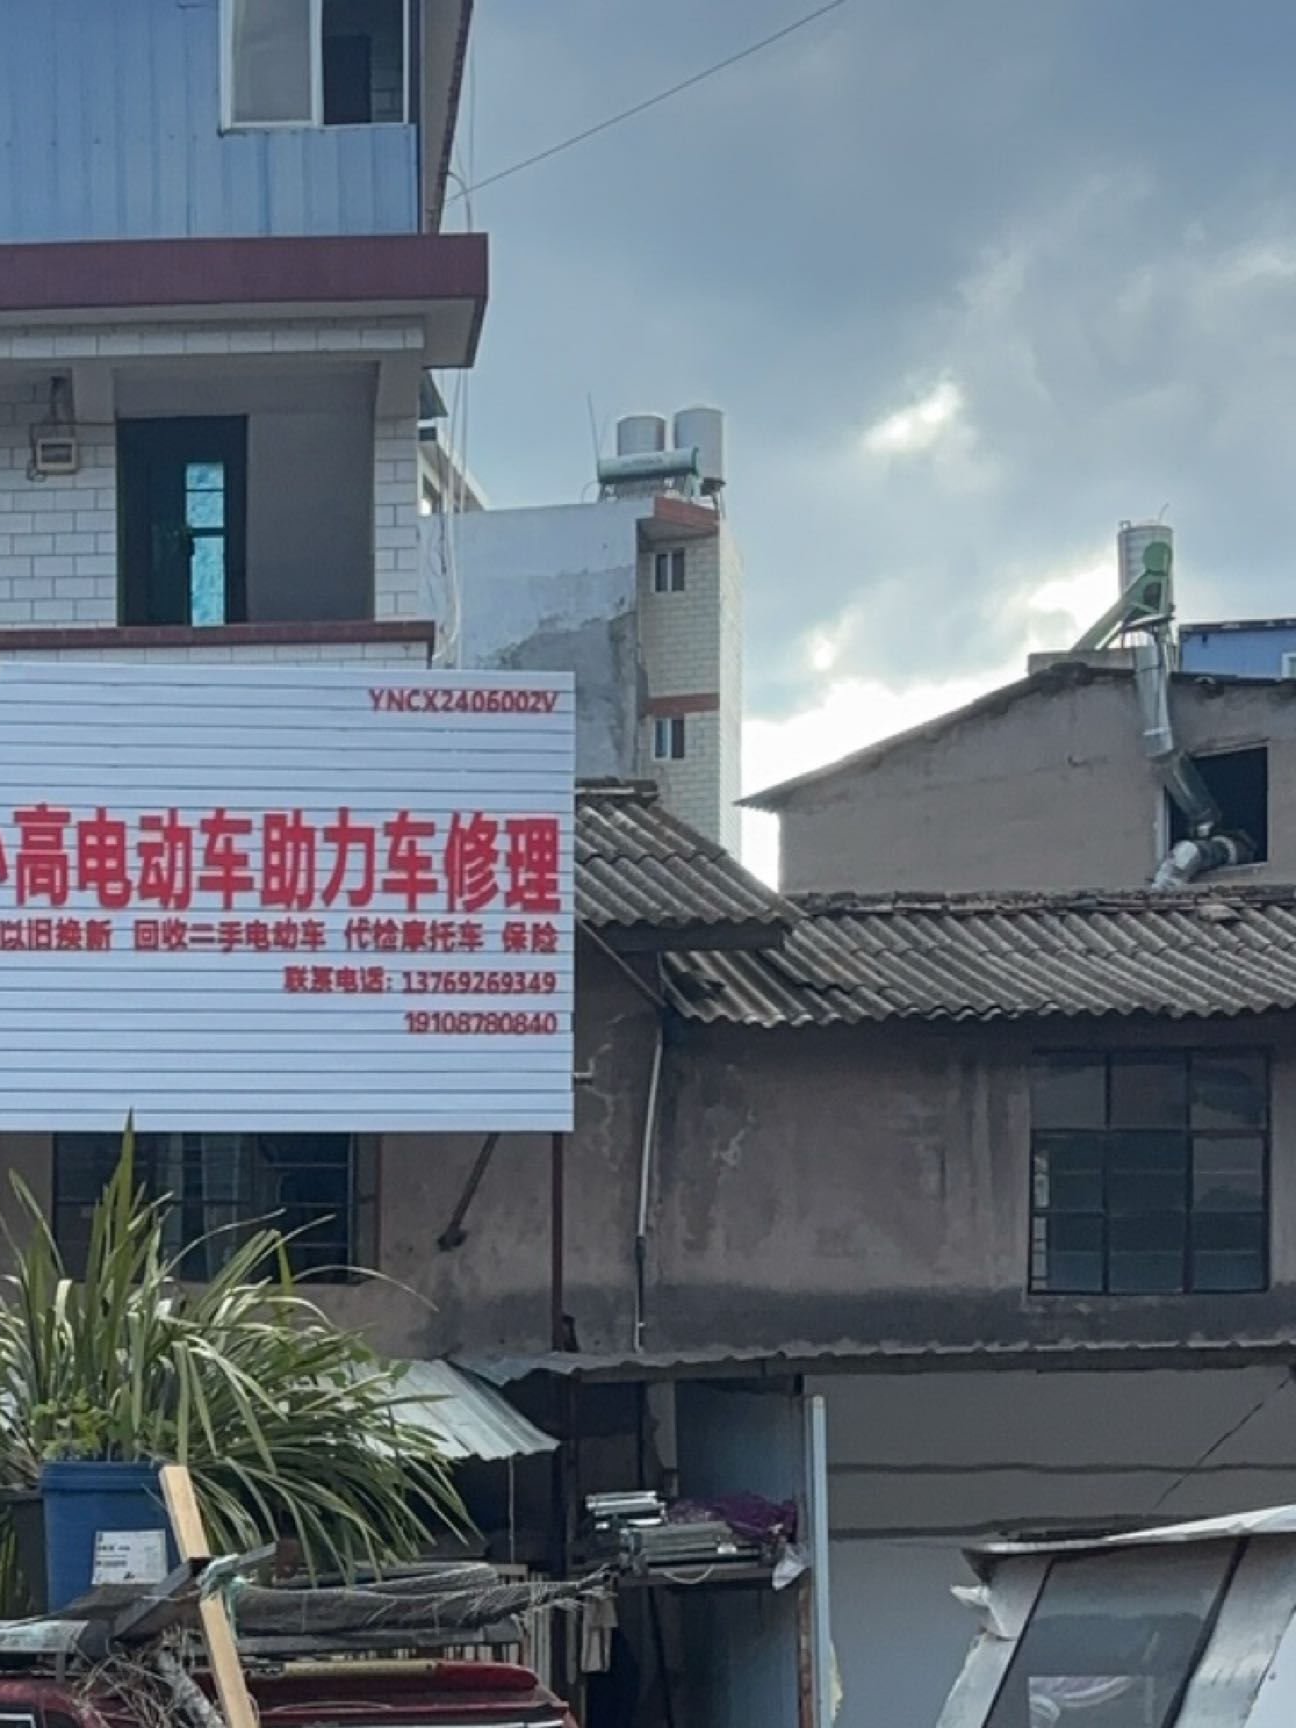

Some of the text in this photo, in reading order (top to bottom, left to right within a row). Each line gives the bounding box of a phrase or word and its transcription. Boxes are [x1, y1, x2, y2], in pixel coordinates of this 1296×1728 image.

[369, 688, 558, 714] YNCX2406002V
[134, 917, 326, 952] 回收二手电动车
[502, 921, 558, 953] 保险
[405, 1011, 557, 1035] 19108780840
